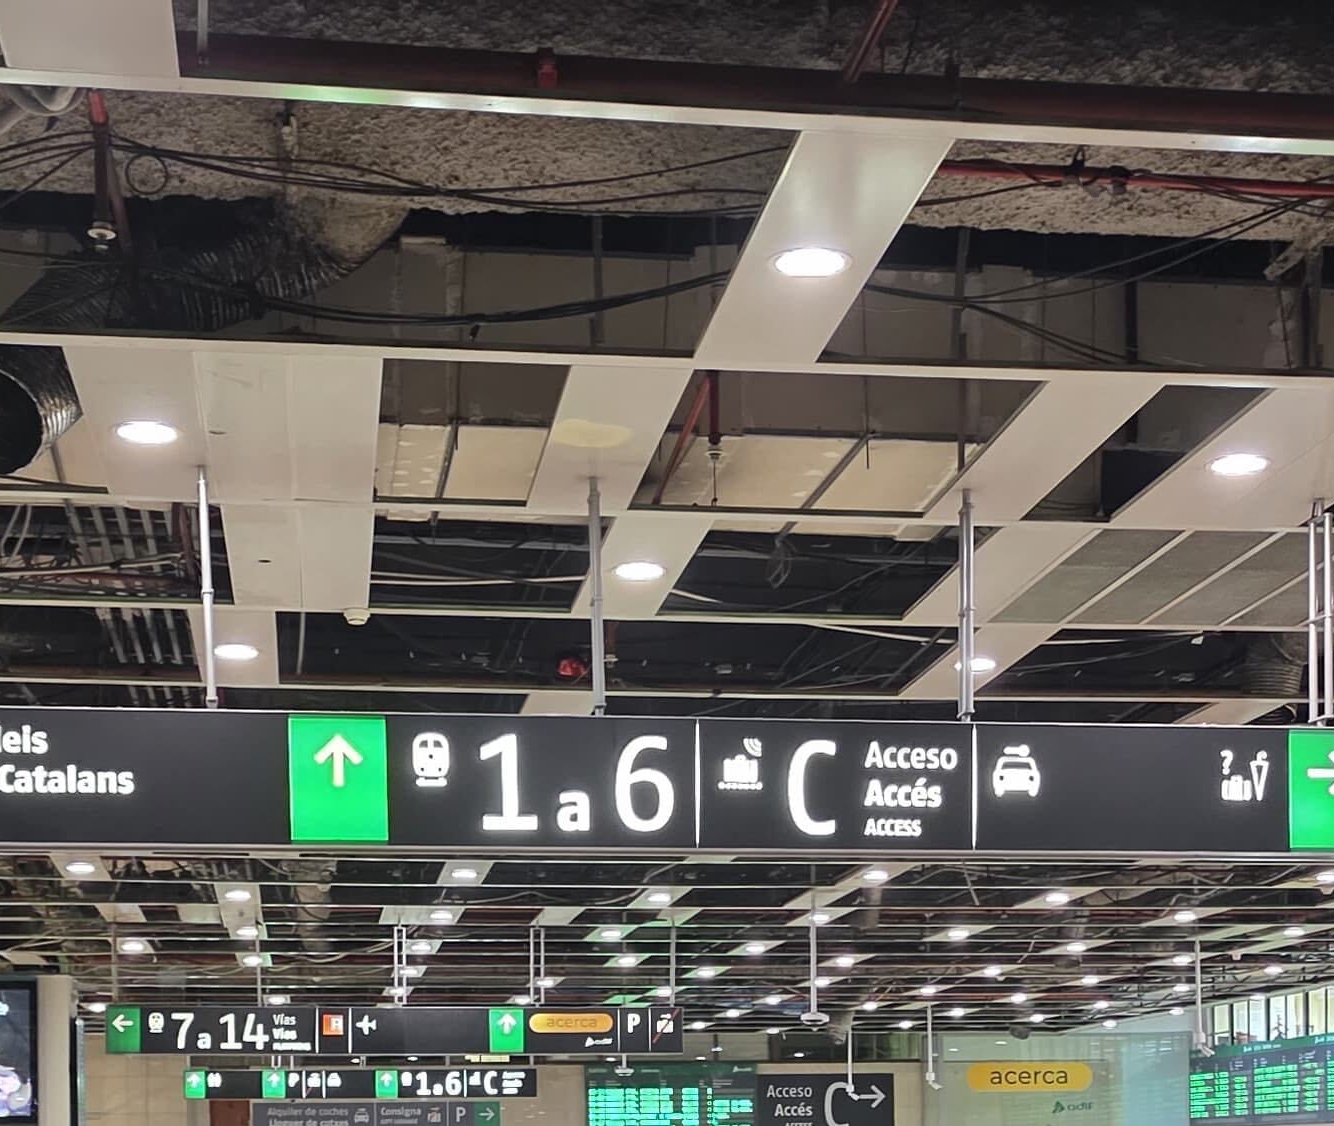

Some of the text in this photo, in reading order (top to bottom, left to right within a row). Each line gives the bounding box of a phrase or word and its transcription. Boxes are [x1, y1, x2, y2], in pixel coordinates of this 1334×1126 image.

[864, 740, 958, 771] Acceso
[478, 732, 675, 833] 1 a 6
[787, 738, 837, 836] C
[863, 775, 943, 808] Accés
[863, 817, 922, 837] ACCESS
[170, 1012, 270, 1050] 7 a 14
[545, 1016, 598, 1029] acerca
[627, 1013, 641, 1034] P
[483, 1070, 499, 1096] C
[989, 1069, 1069, 1085] acerca
[766, 1084, 813, 1098] Acceso
[455, 1106, 466, 1122] P
[774, 1102, 813, 1117] Accés
